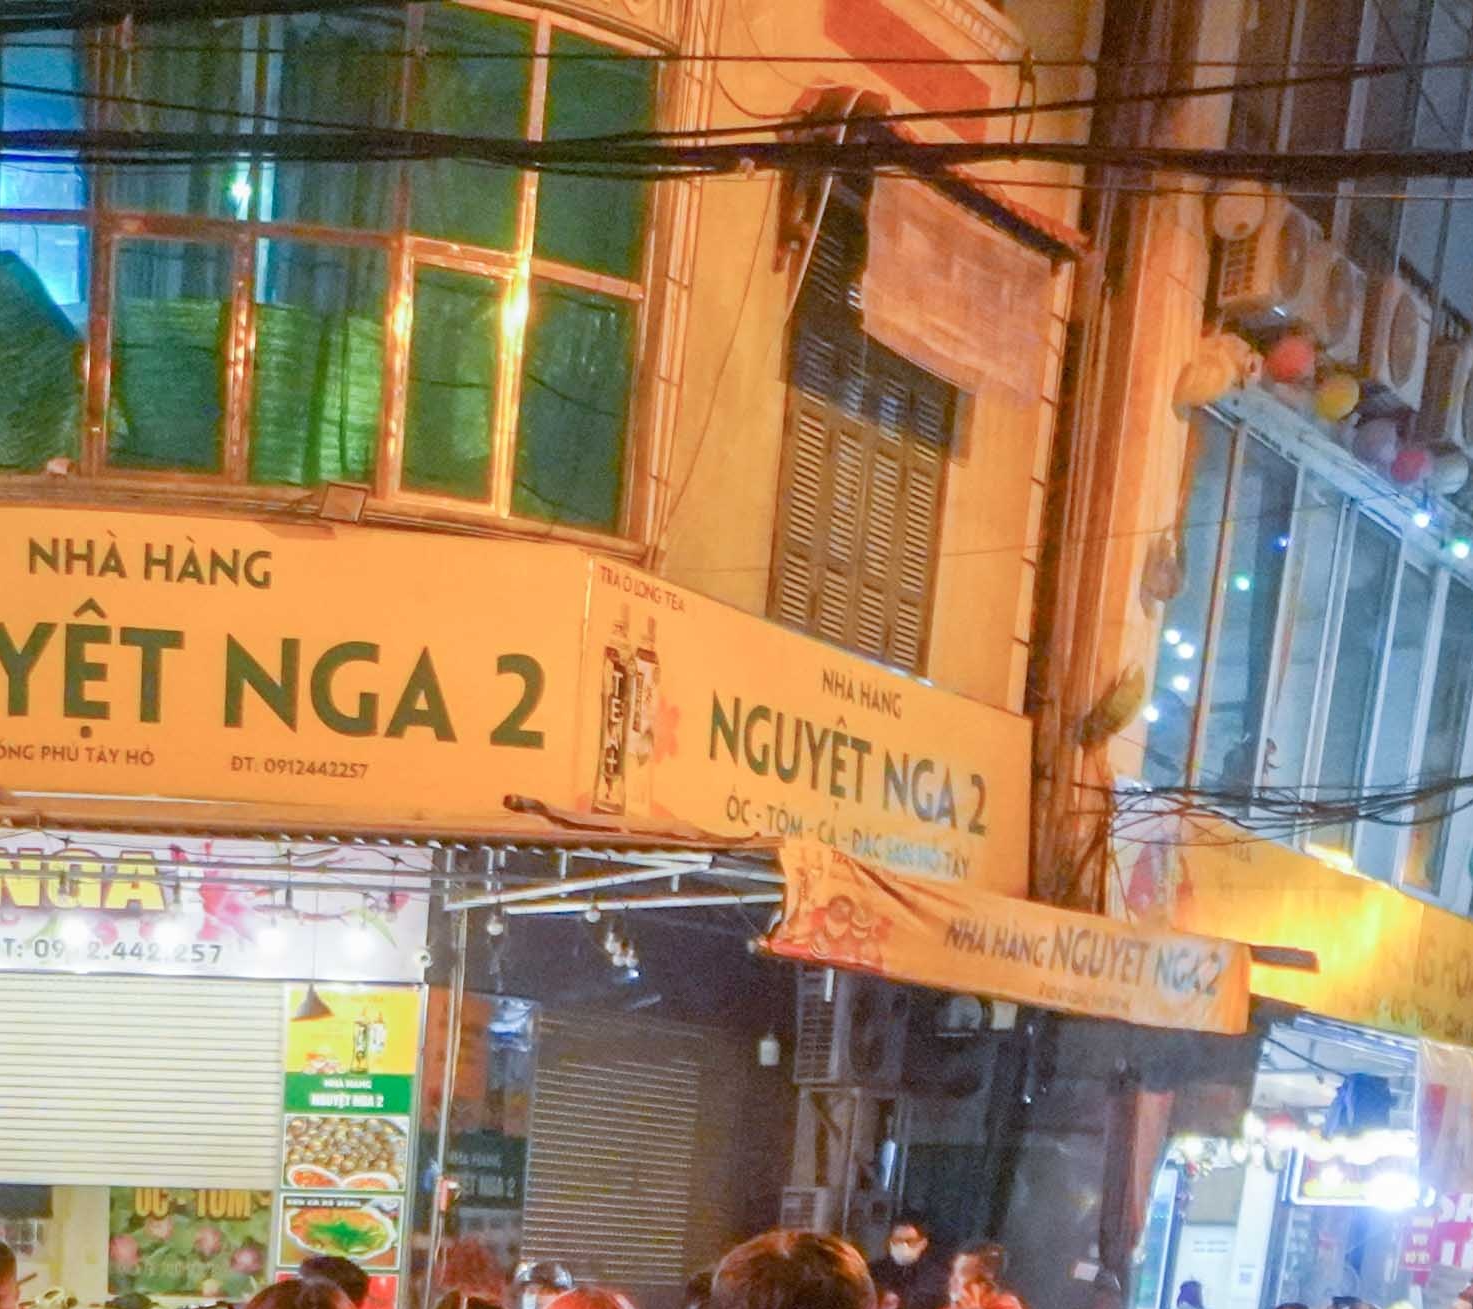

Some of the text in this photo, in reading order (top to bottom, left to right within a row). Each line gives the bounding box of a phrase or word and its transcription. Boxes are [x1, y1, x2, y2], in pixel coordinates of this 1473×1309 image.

[25, 537, 275, 591] NHÀ HÀNG
[223, 632, 457, 744] NGA
[489, 652, 546, 752] 2
[262, 757, 370, 782] 0912442257
[709, 690, 872, 811] NGUYỆT
[884, 748, 957, 828] NGA
[968, 773, 988, 836] 2
[1204, 954, 1225, 997] 2
